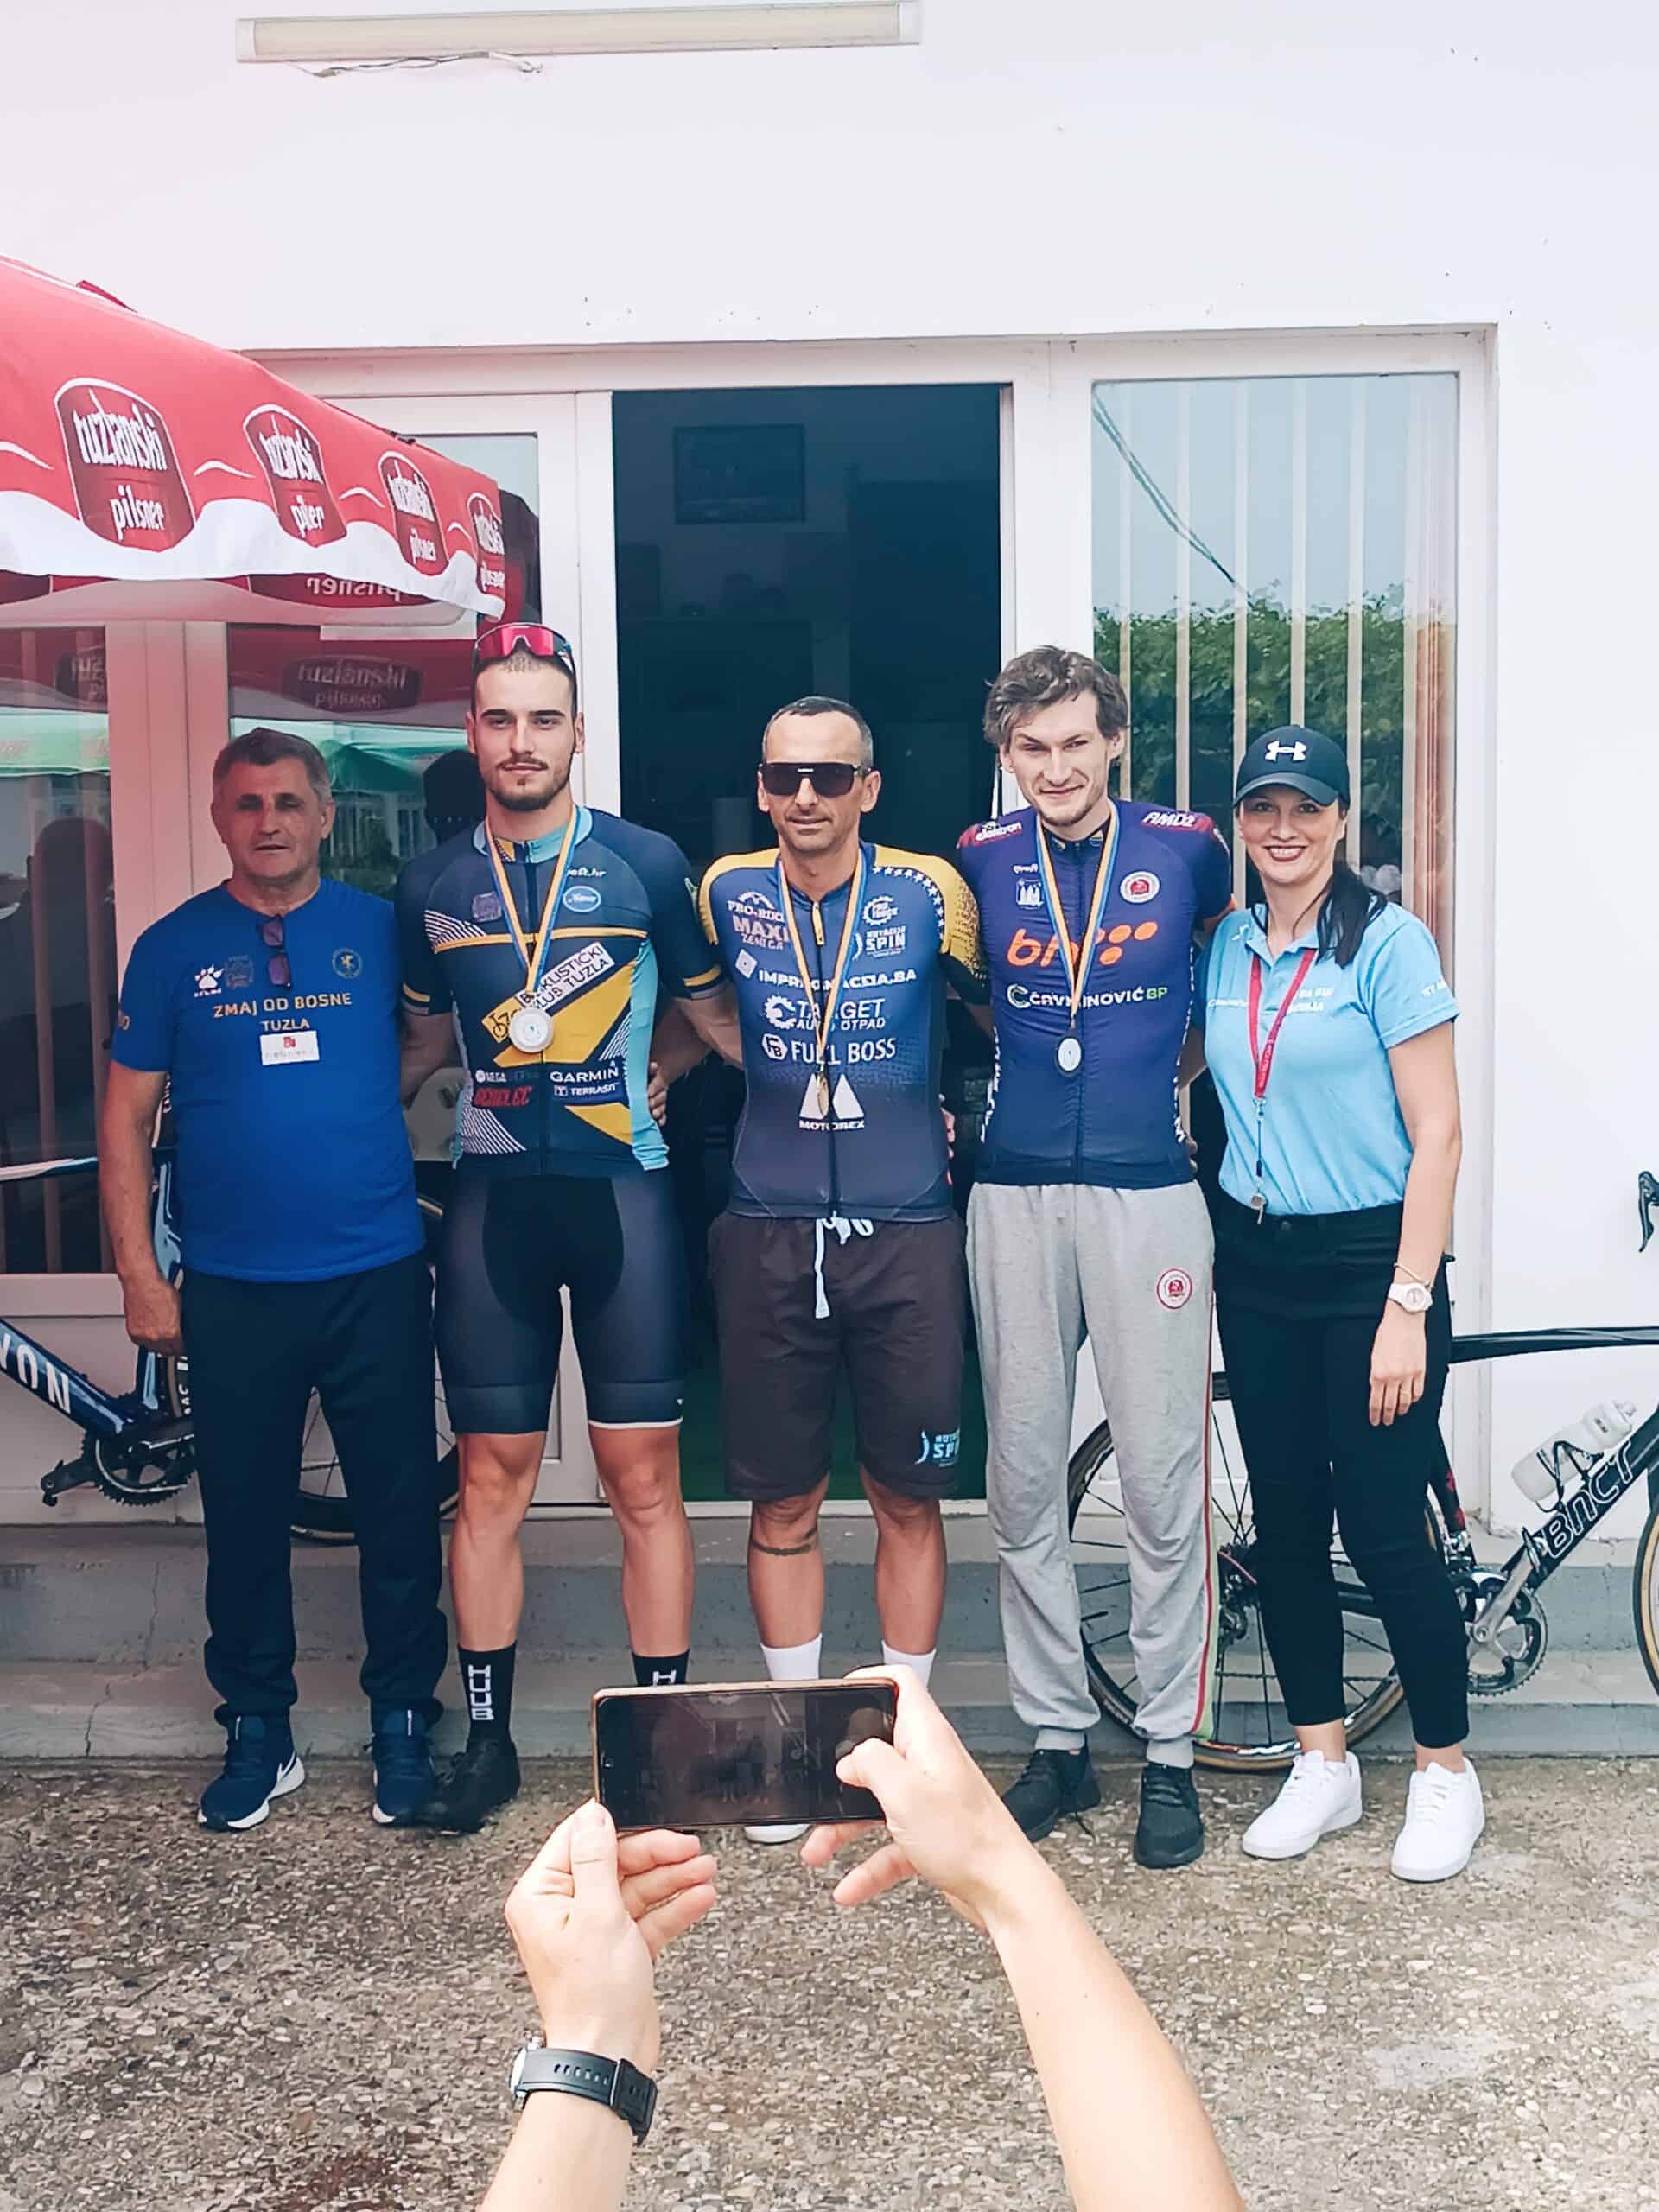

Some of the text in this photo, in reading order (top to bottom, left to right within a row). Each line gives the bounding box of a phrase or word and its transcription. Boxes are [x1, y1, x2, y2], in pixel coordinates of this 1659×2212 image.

[732, 914, 790, 944] MAXI
[563, 957, 610, 988] TUZLA
[213, 992, 353, 1019] ZMAJ OD BOSNE
[795, 996, 887, 1020] TAGET
[259, 1017, 311, 1032] TUZLA
[839, 1016, 887, 1032] OTPAD
[847, 1037, 897, 1064] BOSS
[549, 1066, 620, 1084] GARMIN
